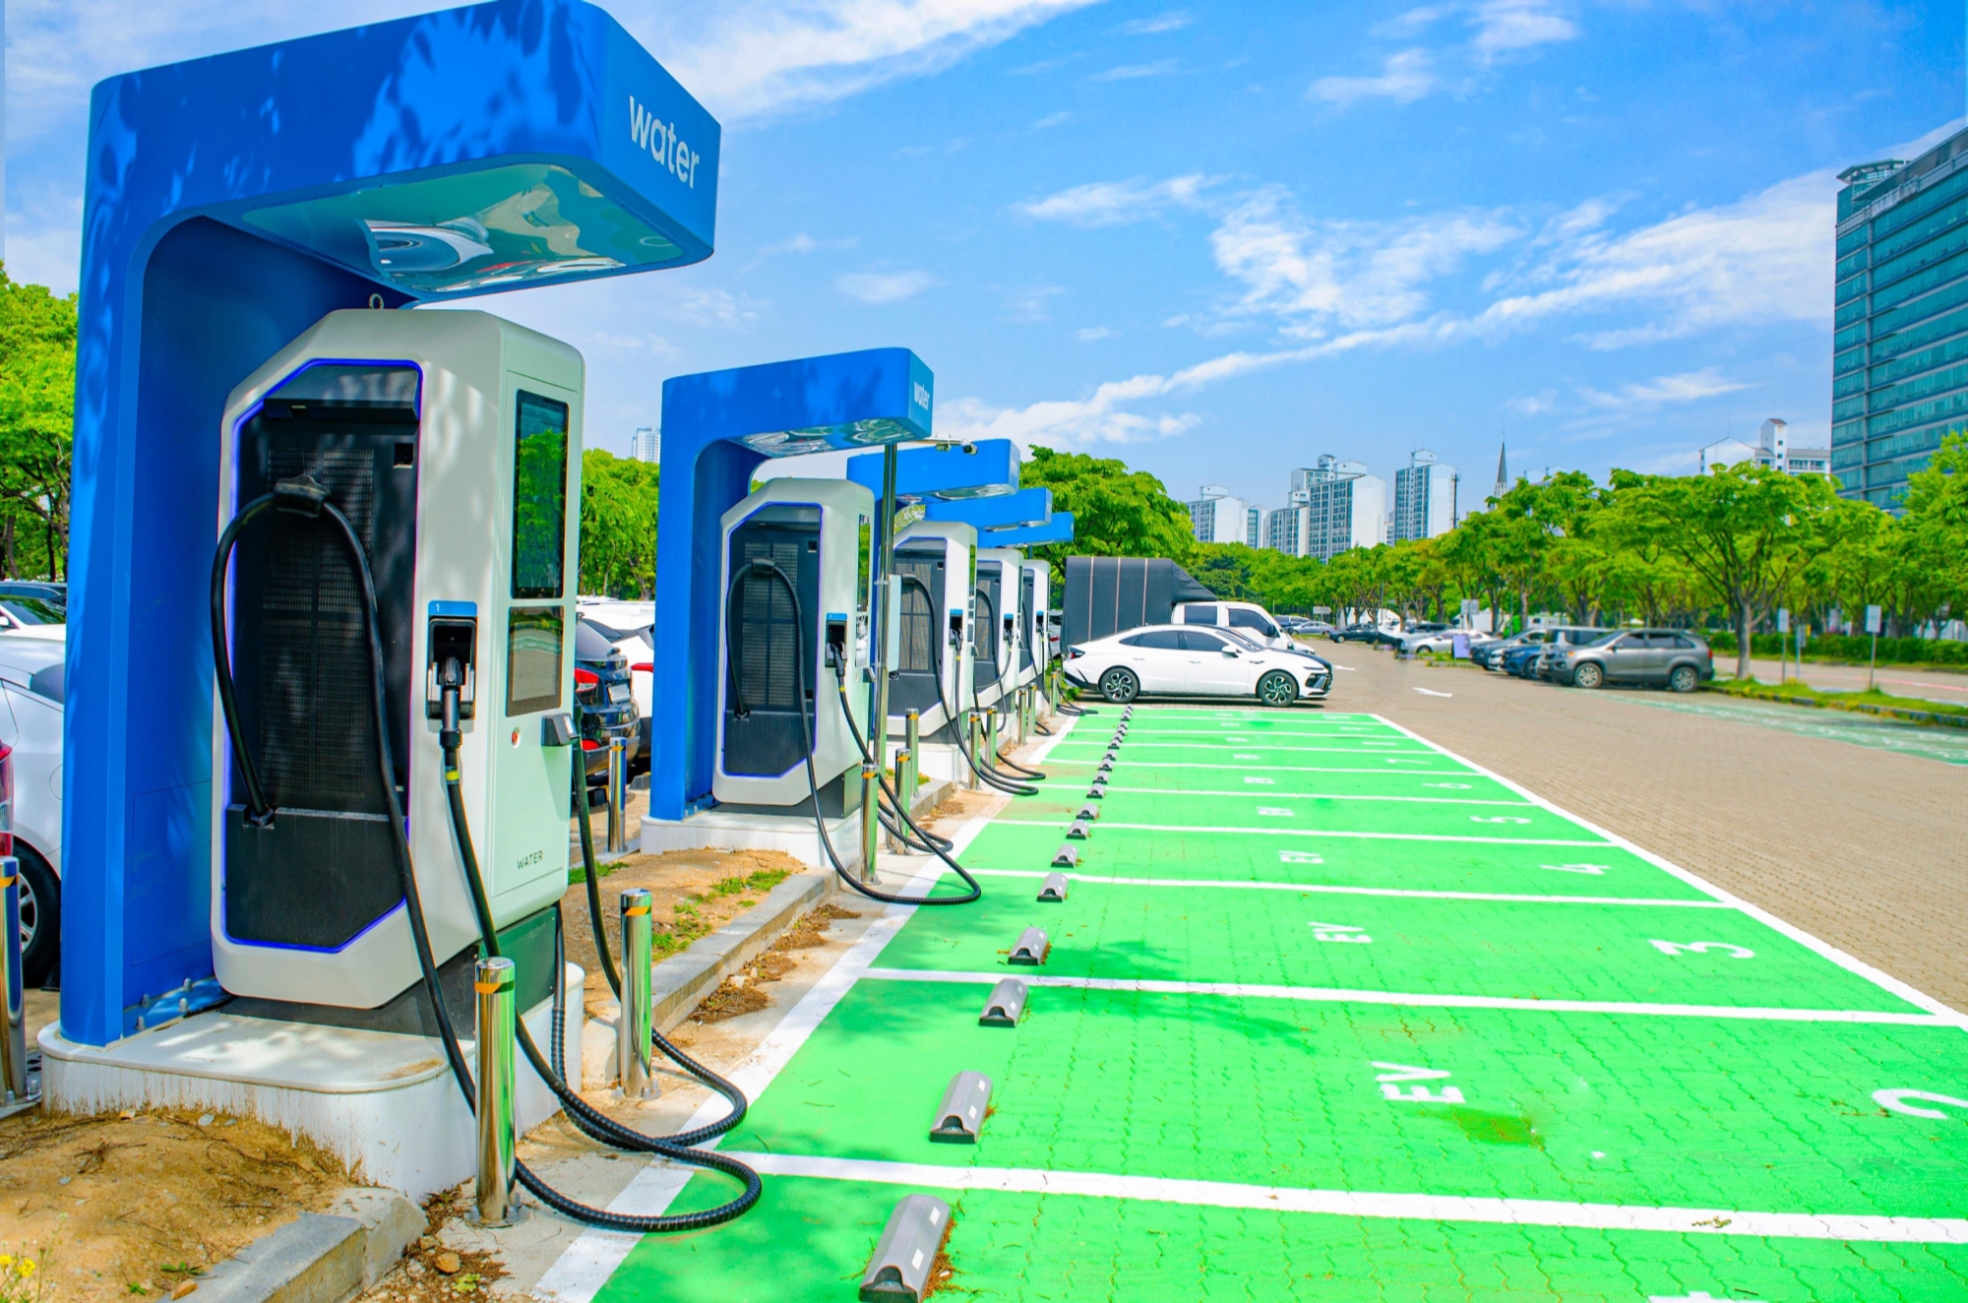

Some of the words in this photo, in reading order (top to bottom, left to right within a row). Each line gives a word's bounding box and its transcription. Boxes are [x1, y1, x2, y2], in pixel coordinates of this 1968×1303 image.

[629, 95, 700, 189] water
[435, 603, 440, 612] 1
[517, 850, 544, 870] WATER
[1278, 850, 1325, 864] EV
[1539, 863, 1611, 875] 4
[1307, 921, 1373, 944] EV
[1647, 939, 1756, 959] 3
[1370, 1060, 1466, 1104] EV
